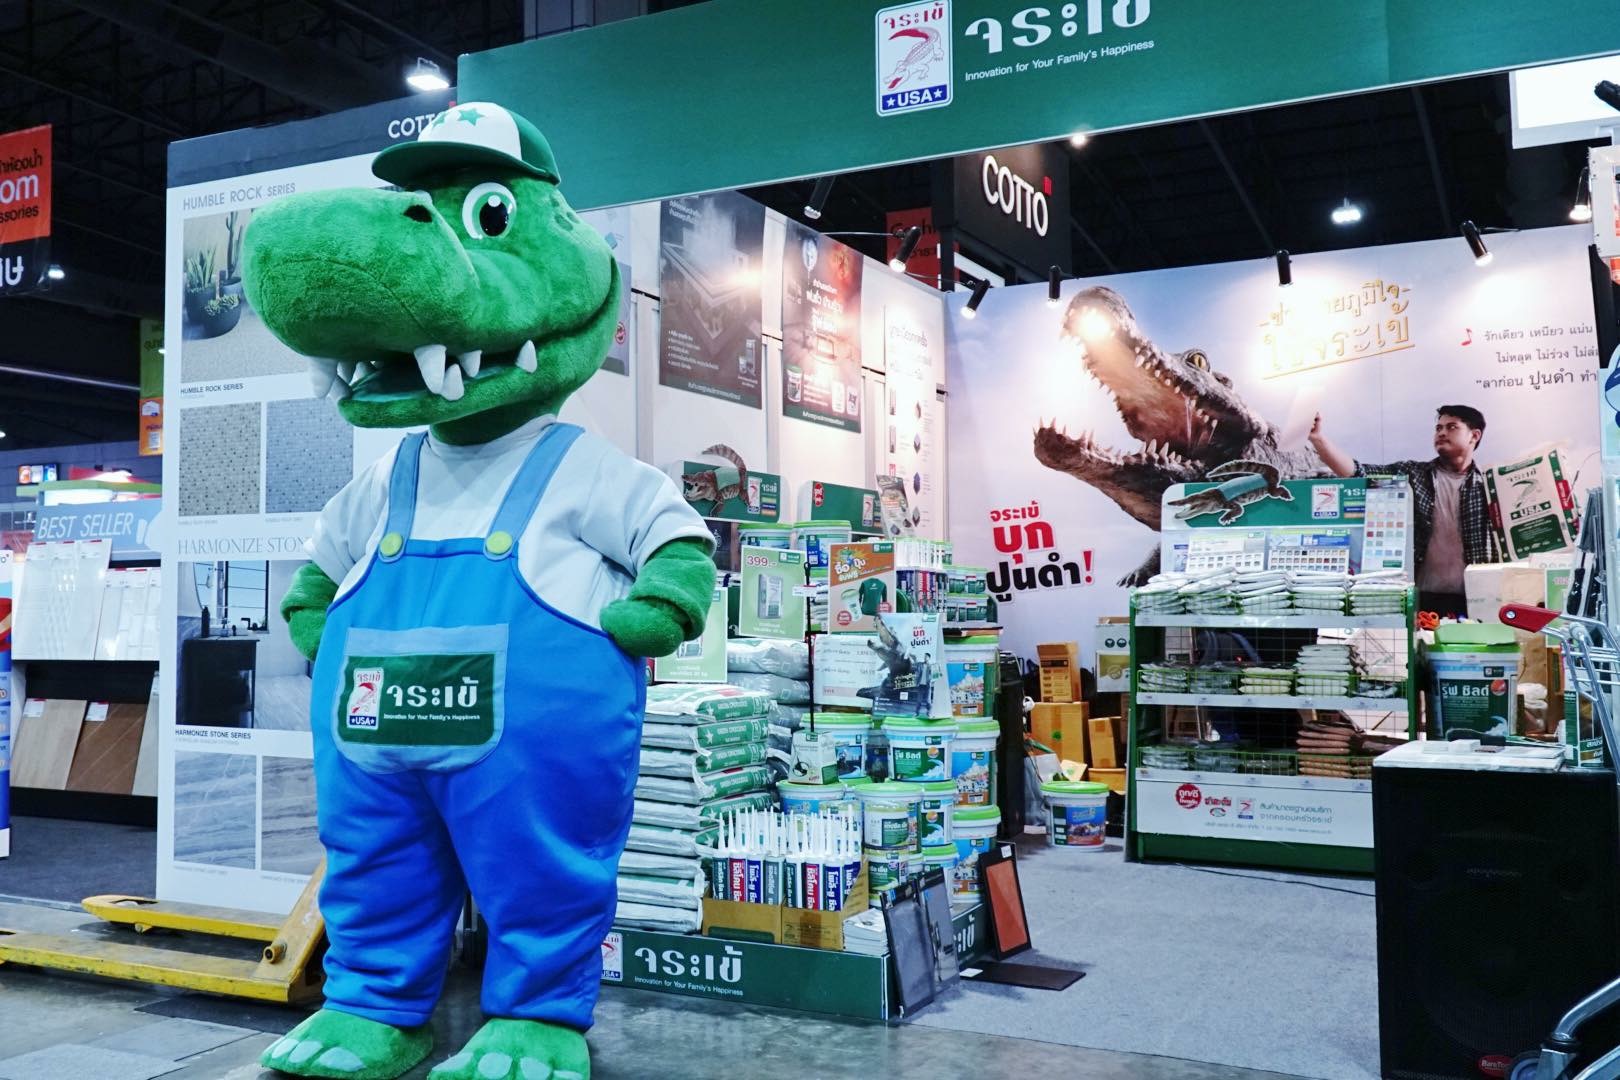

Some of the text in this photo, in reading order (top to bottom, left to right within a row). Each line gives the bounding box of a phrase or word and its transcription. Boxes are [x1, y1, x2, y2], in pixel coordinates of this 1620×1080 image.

[883, 2, 944, 29] จระเข้
[965, 40, 1155, 81] Innovation for Your Family's Happiness
[898, 89, 933, 108] USA
[183, 182, 296, 210] HUMBLE ROCK SERIES
[983, 155, 1048, 237] COTTO
[1569, 322, 1593, 335] แน่น
[181, 383, 243, 394] HUMBLE ROCK SERIES
[1529, 368, 1574, 390] ปูนดำ
[990, 501, 1040, 521] จระเข้
[38, 512, 134, 539] BEST SELLER
[178, 537, 263, 554] HARMONIZE
[993, 521, 1055, 565] บุก
[986, 550, 1092, 602] ปูนดำ!
[386, 677, 479, 707] จระเข้
[634, 945, 743, 983] จระเข้
[634, 976, 663, 985] Innovation
[688, 983, 711, 991] Family's
[712, 986, 744, 996] Happiness
